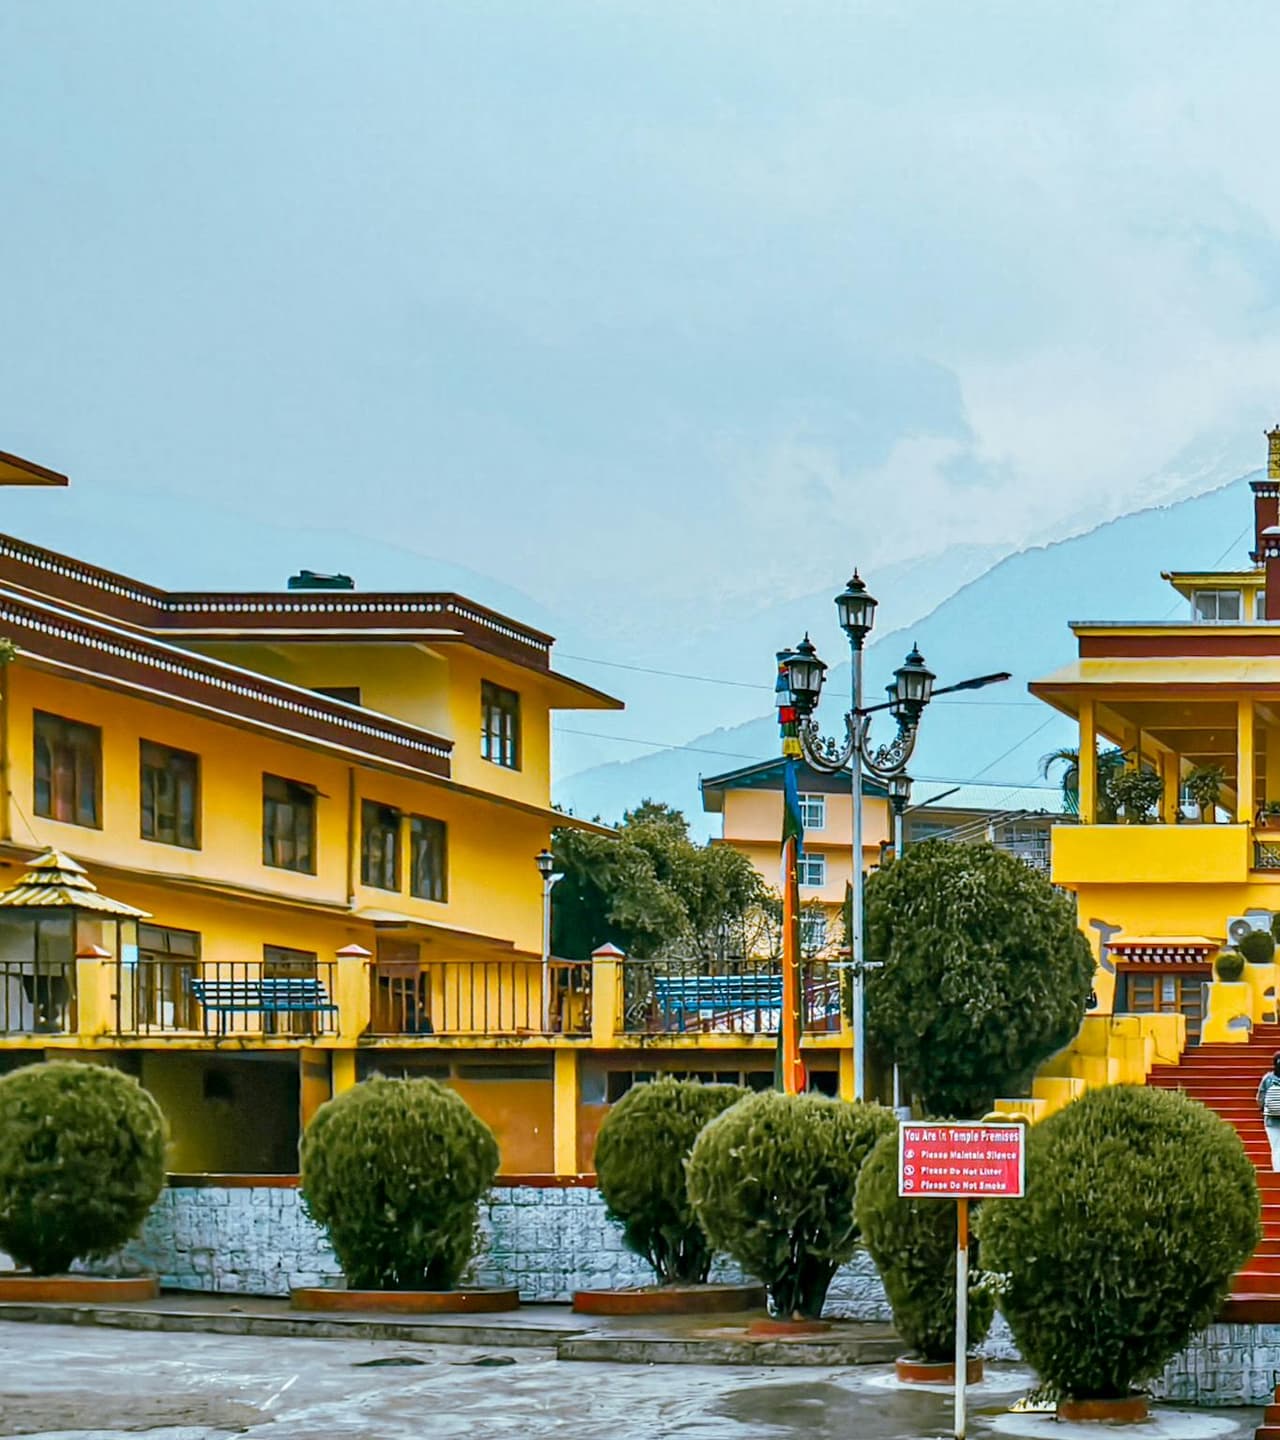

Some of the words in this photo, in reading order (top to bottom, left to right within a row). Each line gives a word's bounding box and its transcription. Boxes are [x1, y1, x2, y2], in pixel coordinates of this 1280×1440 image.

[905, 1130, 920, 1141] You
[922, 1130, 936, 1141] Are
[939, 1130, 947, 1141] In
[949, 1130, 979, 1144] Temple
[981, 1130, 1019, 1142] Premises
[921, 1150, 948, 1160] Please
[950, 1150, 985, 1160] Maintain
[986, 1150, 1017, 1160] Silence
[921, 1166, 947, 1175] Please
[949, 1167, 960, 1175] Do
[962, 1167, 977, 1175] Not
[979, 1167, 1002, 1176] Litter
[921, 1180, 947, 1189] Please
[949, 1180, 960, 1189] Do
[962, 1181, 977, 1190] Not
[979, 1181, 1006, 1190] Smoke
